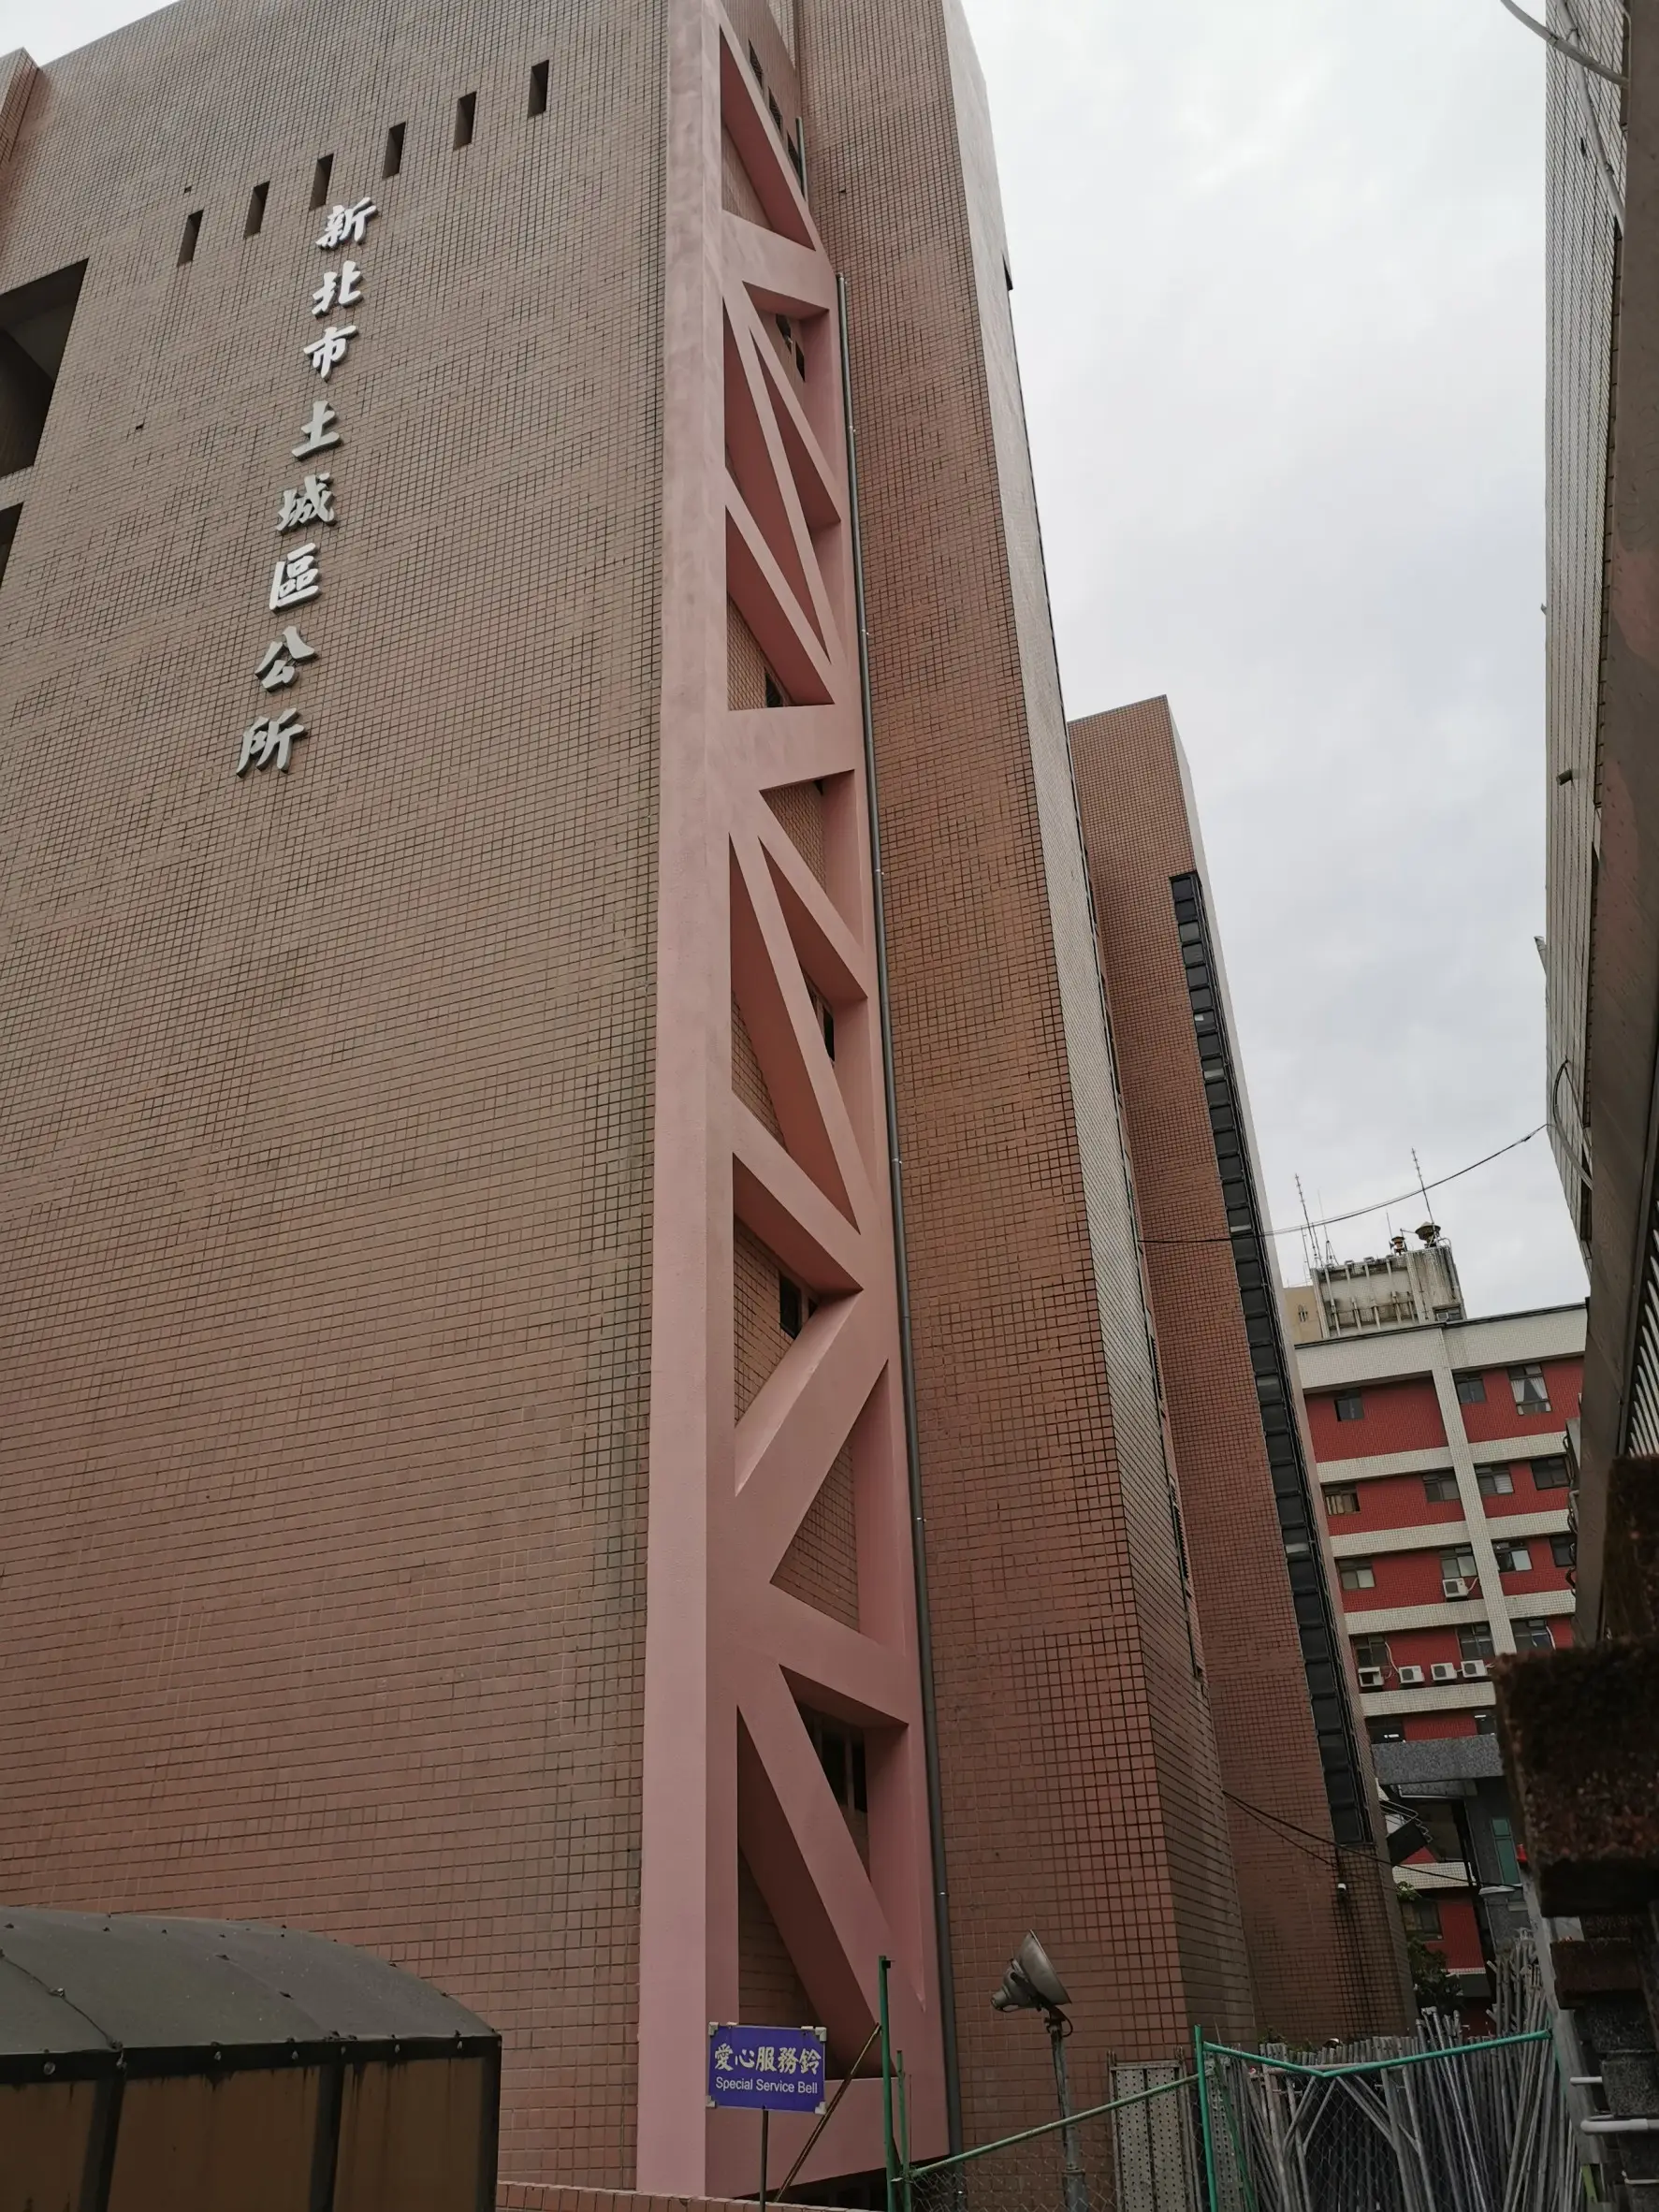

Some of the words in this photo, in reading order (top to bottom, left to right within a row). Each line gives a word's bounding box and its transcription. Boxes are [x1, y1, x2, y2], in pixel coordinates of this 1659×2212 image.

[236, 196, 377, 777] 新北市土城區公所
[714, 2043, 822, 2074] 愛心服務鈴
[715, 2076, 753, 2091] Special
[756, 2078, 795, 2093] Service
[798, 2081, 818, 2094] Bell
